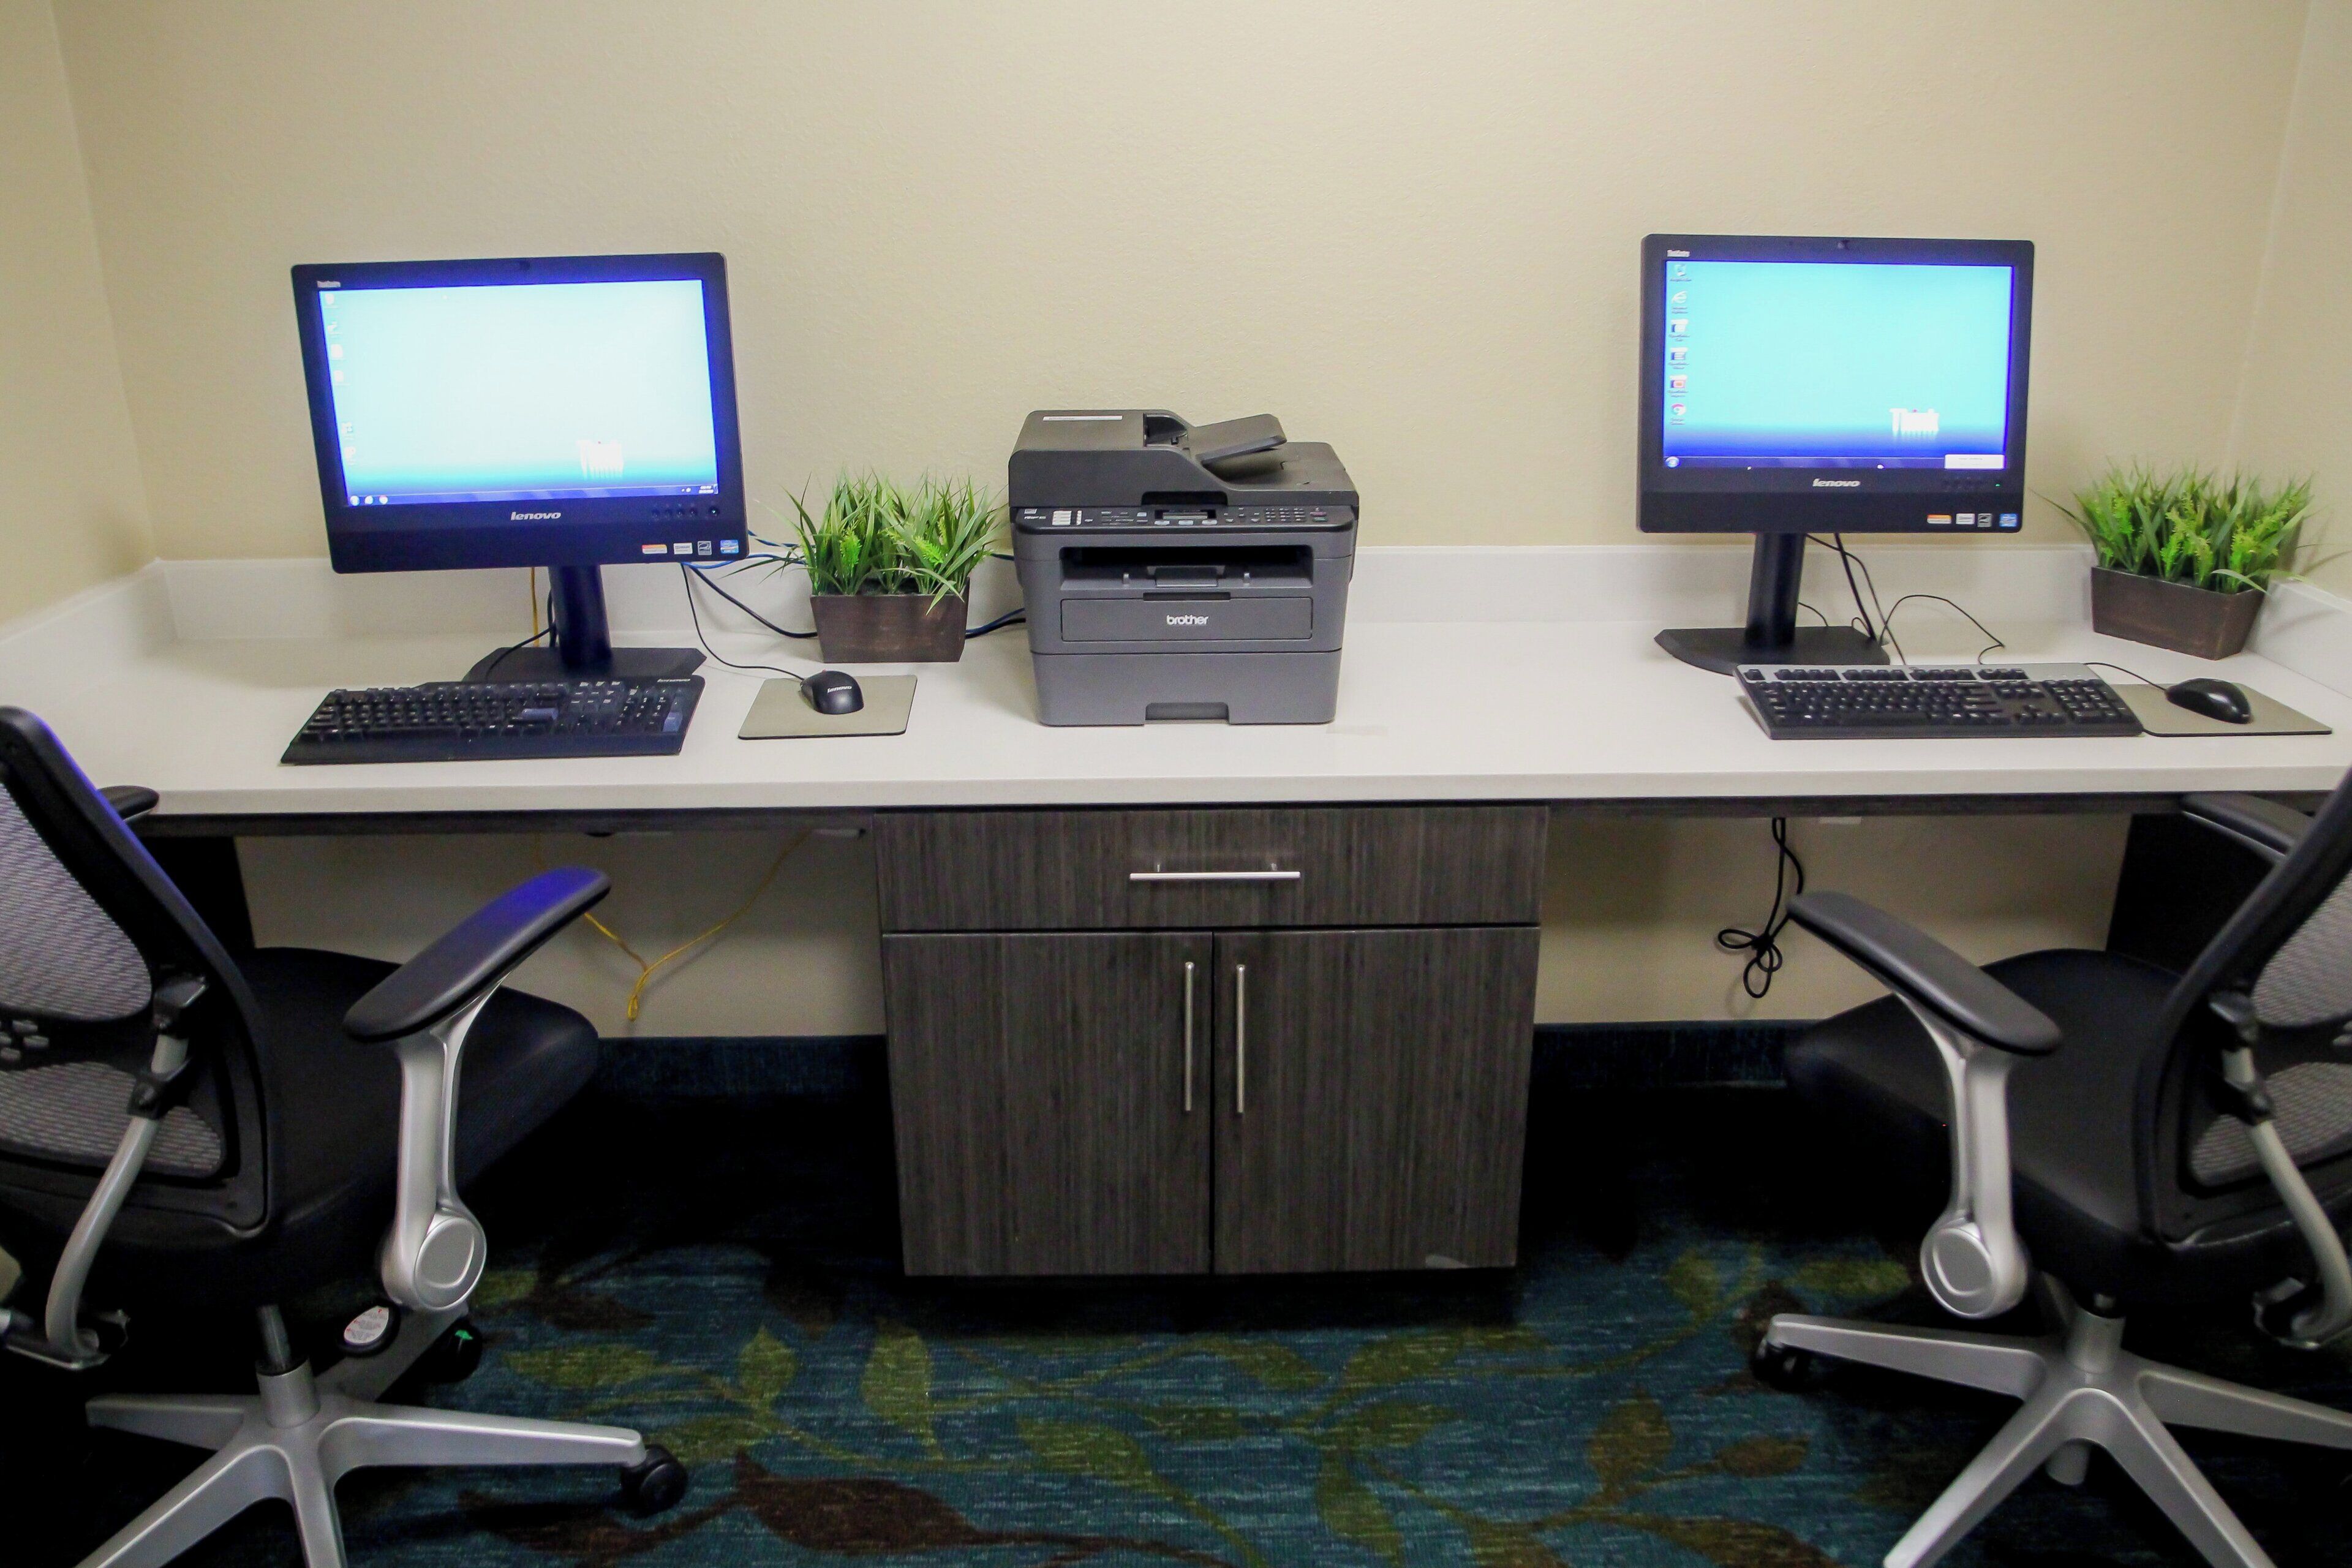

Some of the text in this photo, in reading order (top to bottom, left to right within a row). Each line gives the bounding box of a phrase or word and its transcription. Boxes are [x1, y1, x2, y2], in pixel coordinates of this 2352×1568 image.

[1812, 478, 1861, 487] lenovo
[511, 511, 562, 521] lenovo
[1166, 614, 1209, 625] brother
